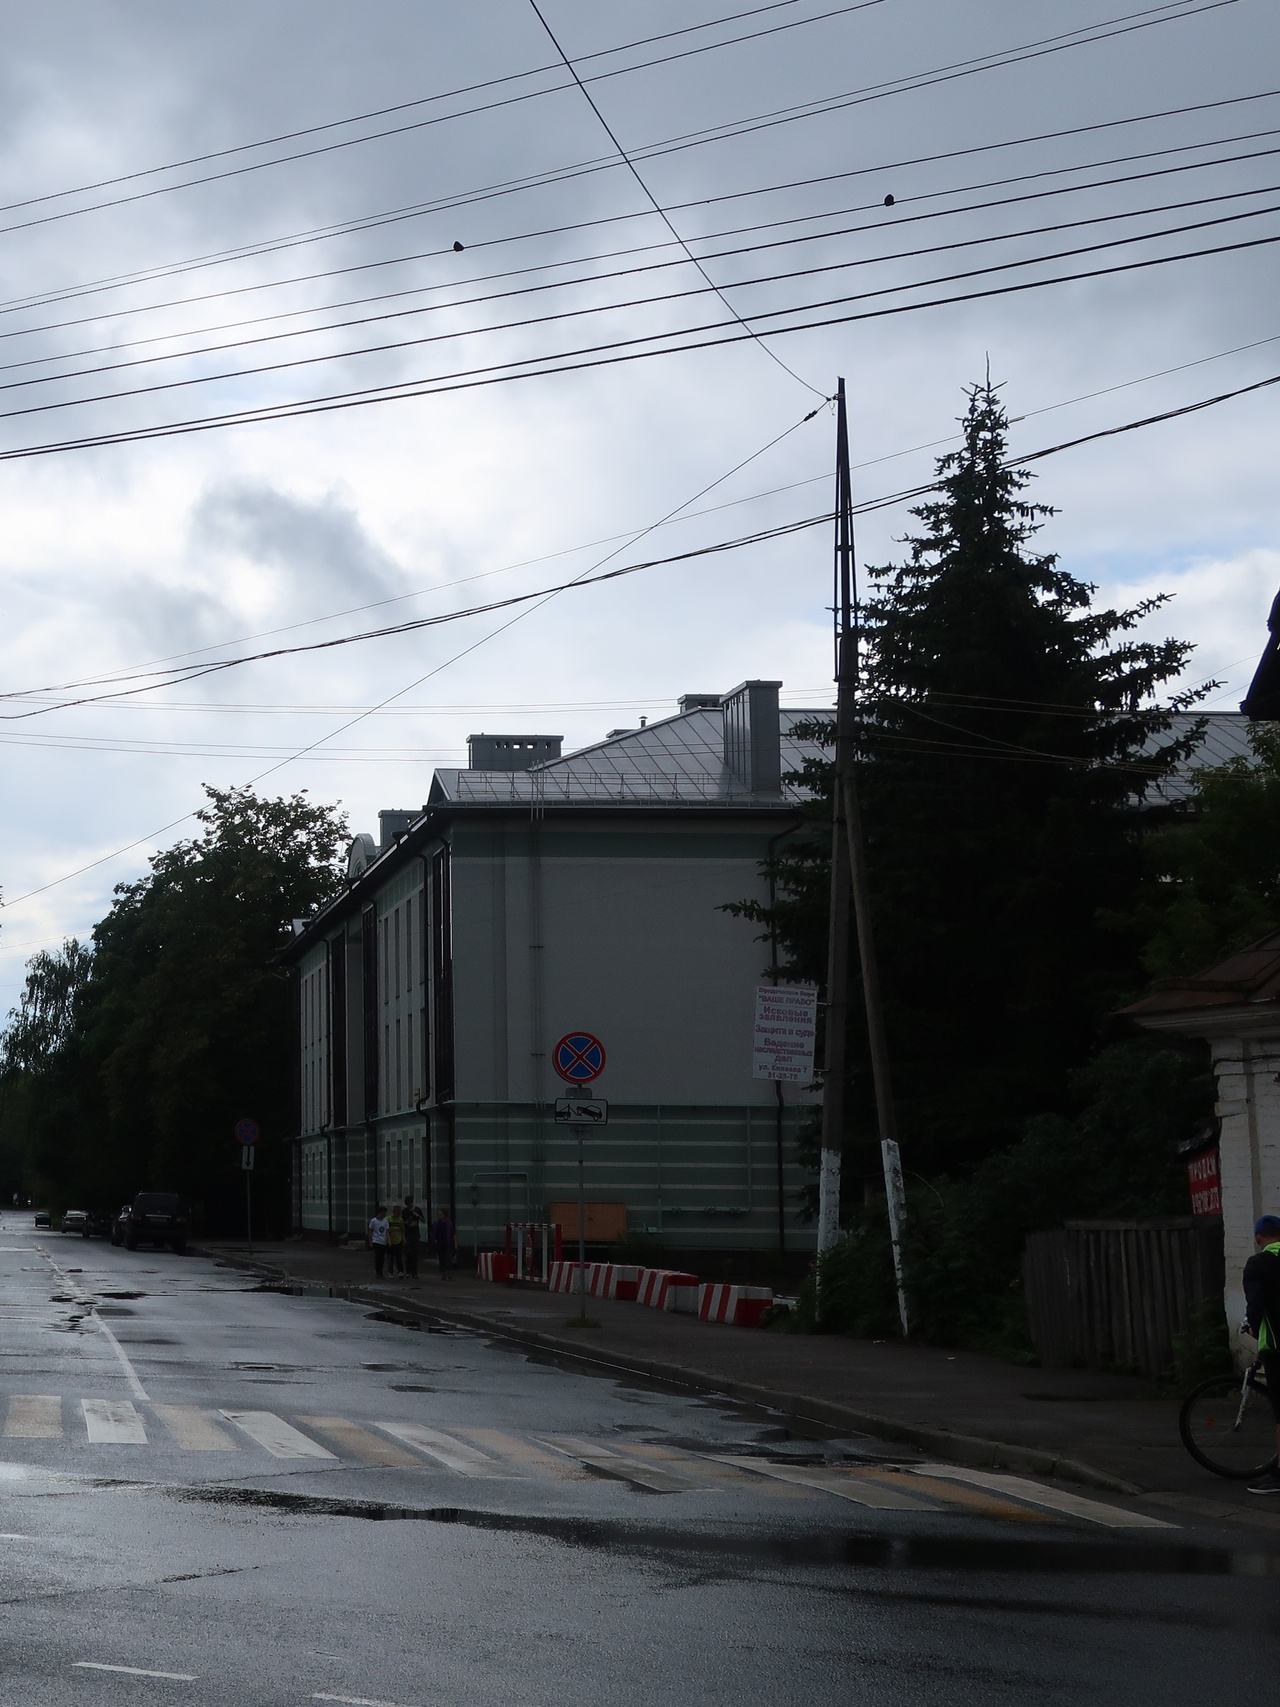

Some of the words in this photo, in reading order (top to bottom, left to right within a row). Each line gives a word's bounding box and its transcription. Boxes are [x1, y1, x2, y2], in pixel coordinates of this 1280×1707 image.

[764, 1006, 808, 1017] Исковые
[759, 1014, 812, 1024] заявления
[755, 1025, 787, 1035] Защита
[795, 1029, 815, 1038] суде
[764, 1038, 805, 1049] Ведение
